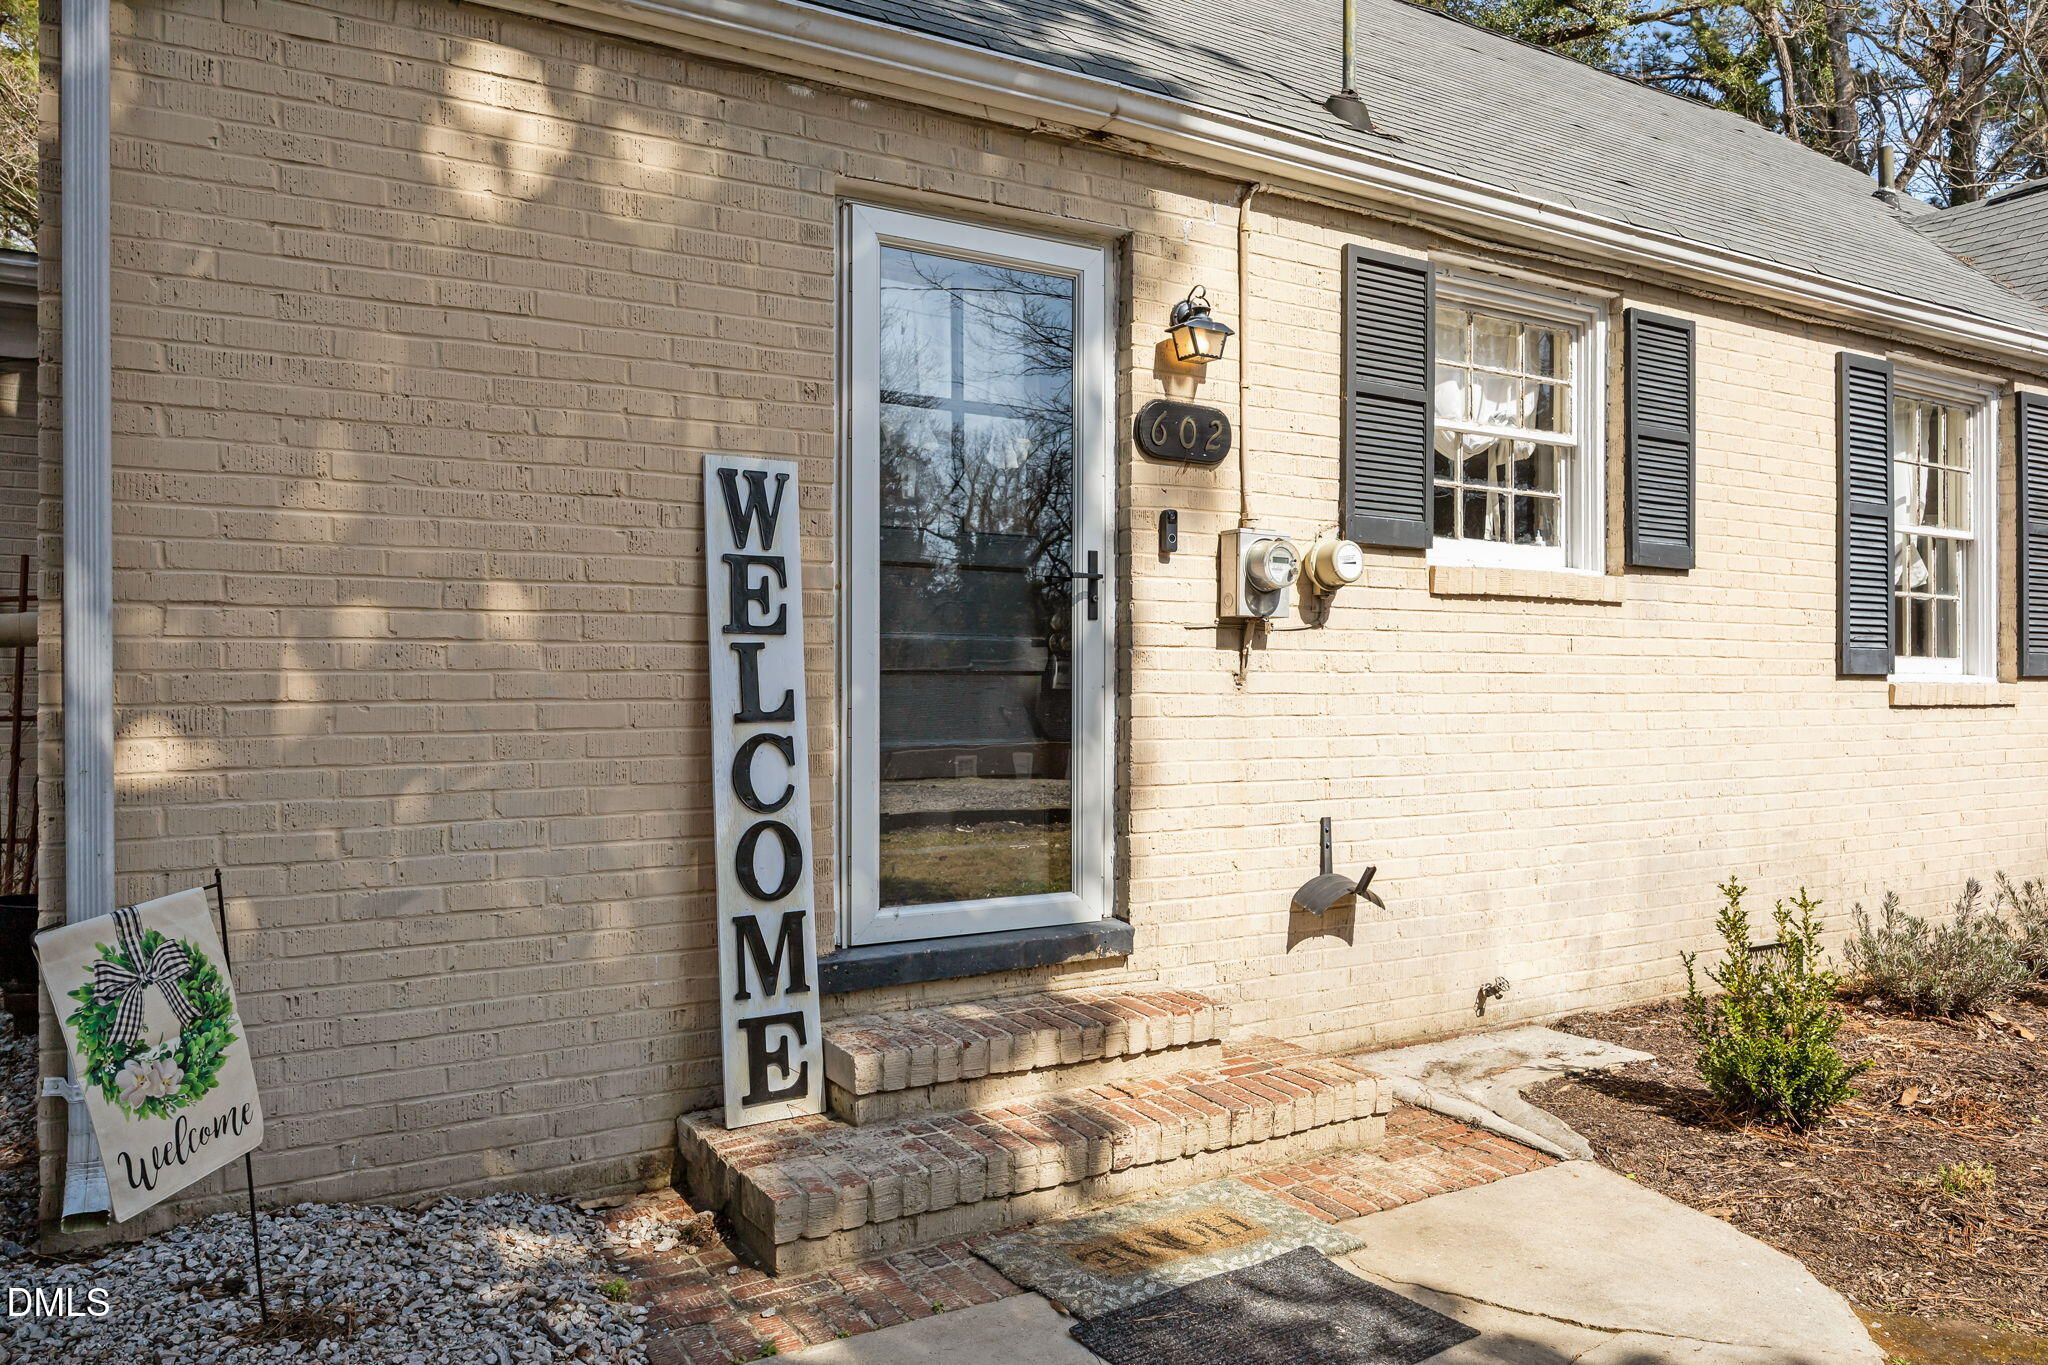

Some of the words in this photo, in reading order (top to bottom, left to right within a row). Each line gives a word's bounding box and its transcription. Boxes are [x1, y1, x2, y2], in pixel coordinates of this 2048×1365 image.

[1151, 410, 1223, 452] 602
[717, 467, 811, 1107] WELCOME
[117, 1101, 254, 1191] Welcome
